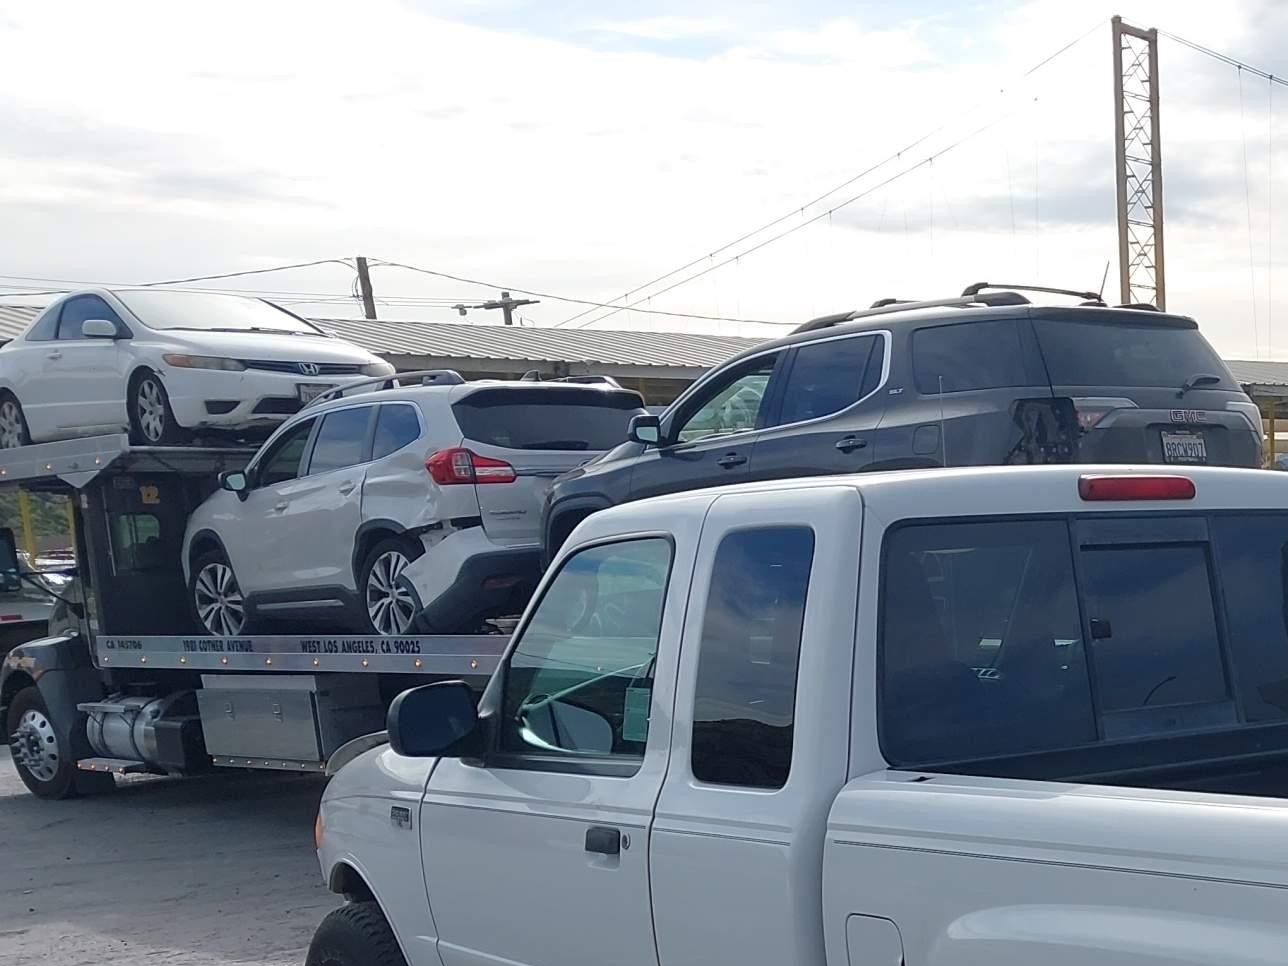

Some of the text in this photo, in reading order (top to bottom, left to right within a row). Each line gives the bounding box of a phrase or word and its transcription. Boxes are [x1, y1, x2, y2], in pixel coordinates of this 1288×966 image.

[1170, 409, 1208, 423] GMC
[227, 640, 254, 653] AVENUE
[302, 640, 421, 654] WEST LOS ANGELES, CA 90025
